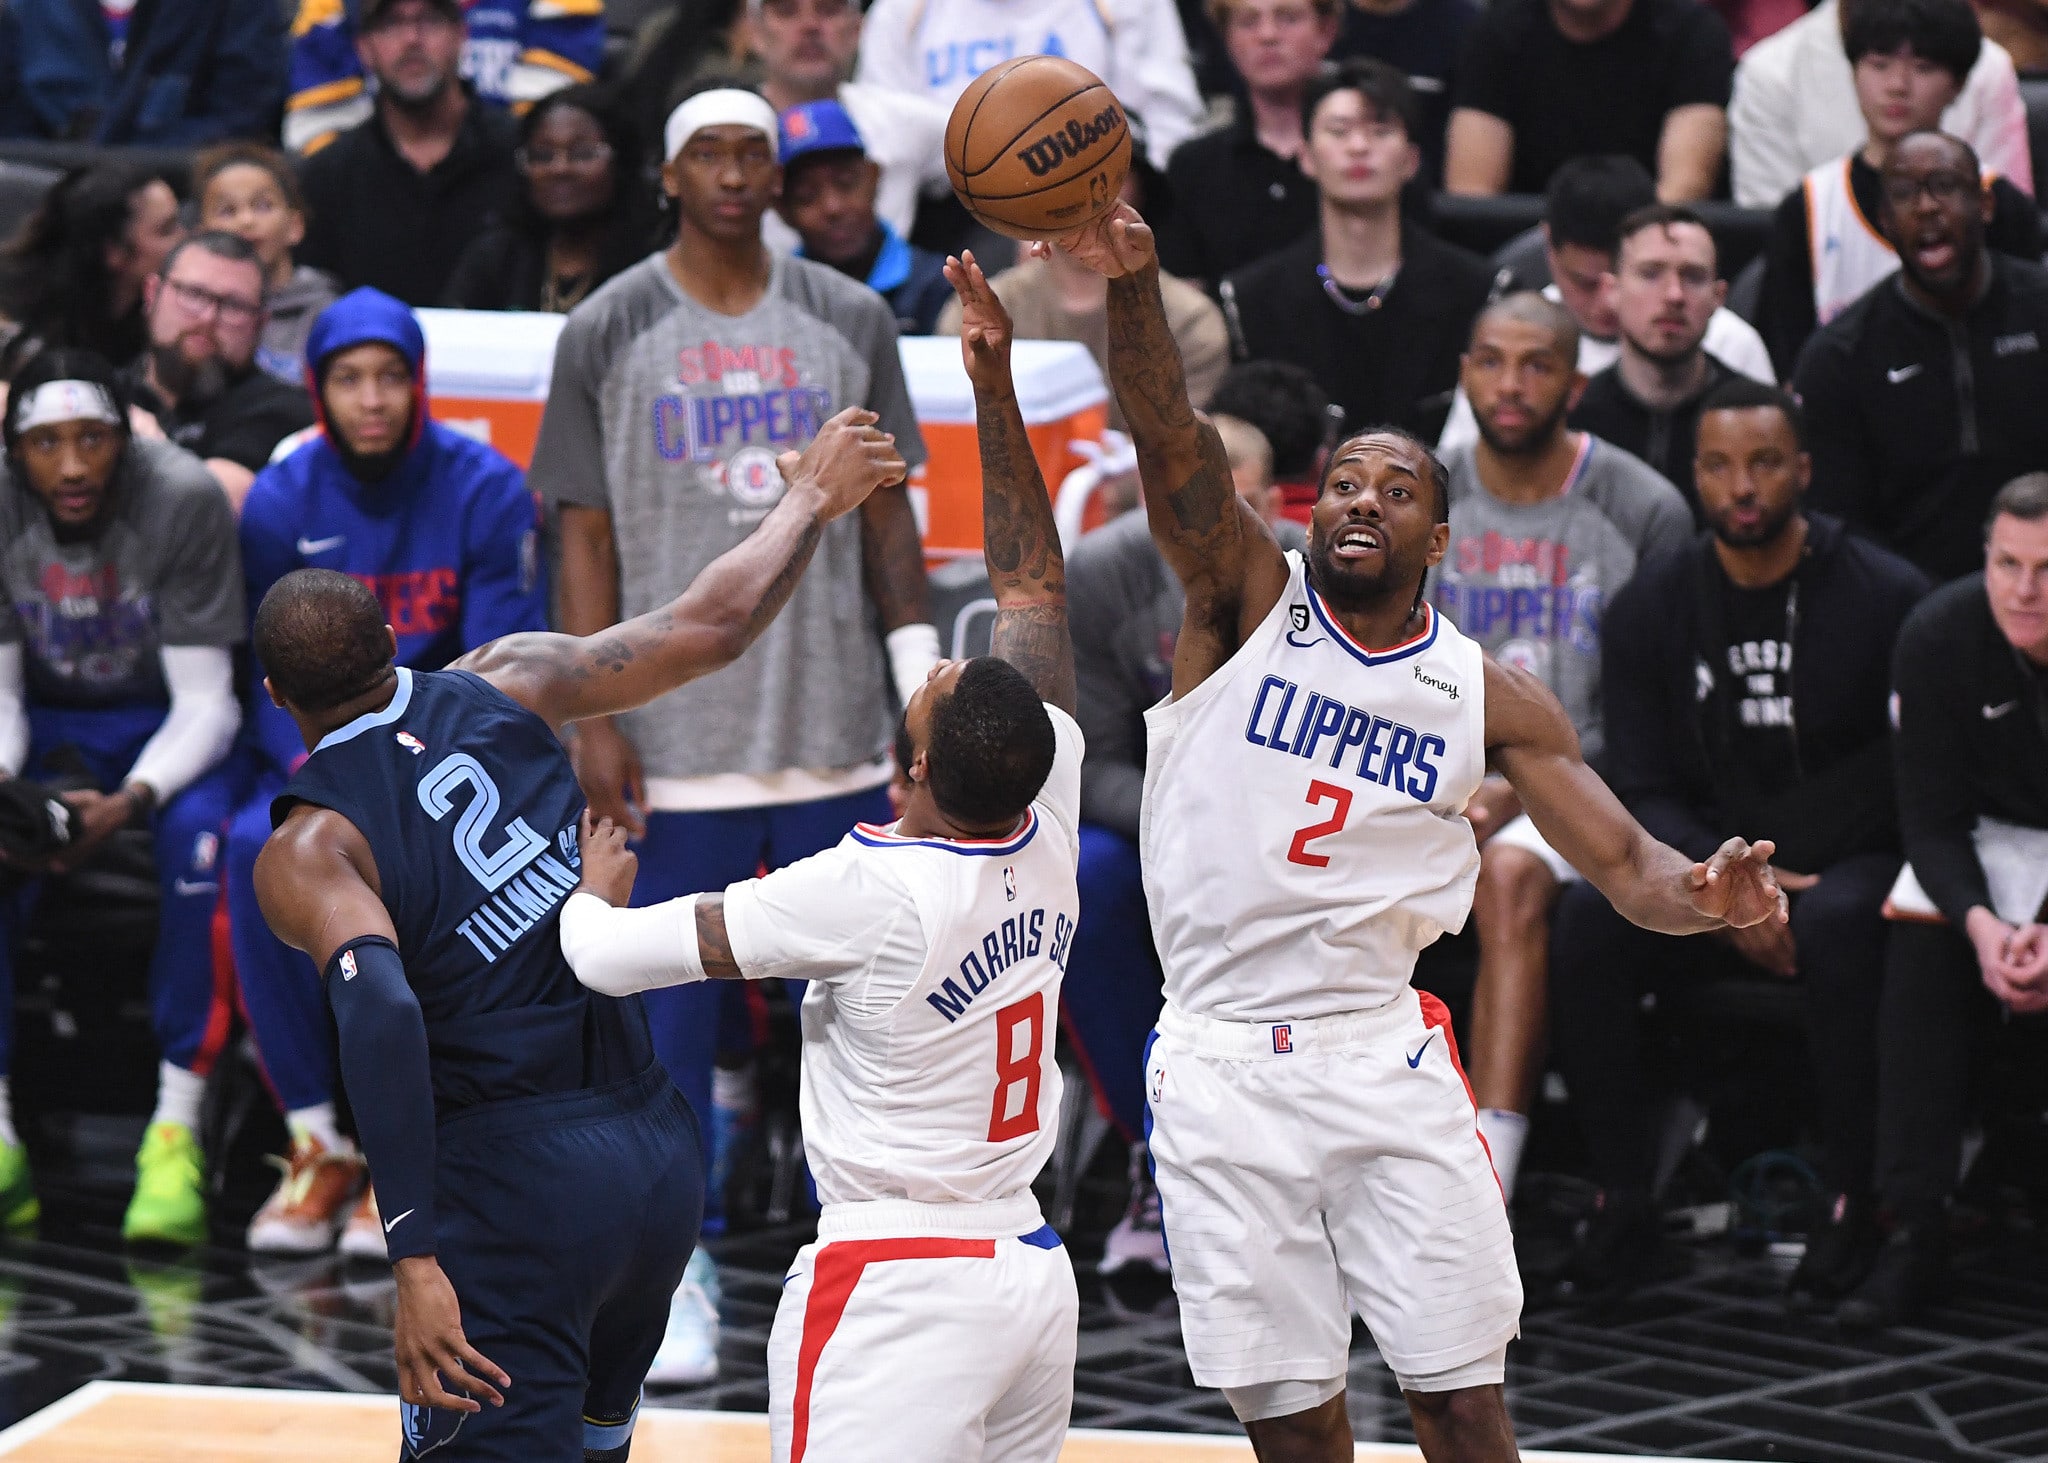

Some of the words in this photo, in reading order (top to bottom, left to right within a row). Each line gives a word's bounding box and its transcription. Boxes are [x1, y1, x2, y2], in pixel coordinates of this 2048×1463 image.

[926, 33, 1067, 87] UCA
[1017, 105, 1121, 176] Wilson
[1245, 674, 1446, 803] CLIPPERS
[1413, 665, 1460, 700] honey
[417, 753, 551, 893] 2
[1287, 779, 1354, 868] 2
[455, 851, 581, 963] TILLMAN
[926, 908, 1045, 1024] MORRIS
[987, 991, 1044, 1143] 8
